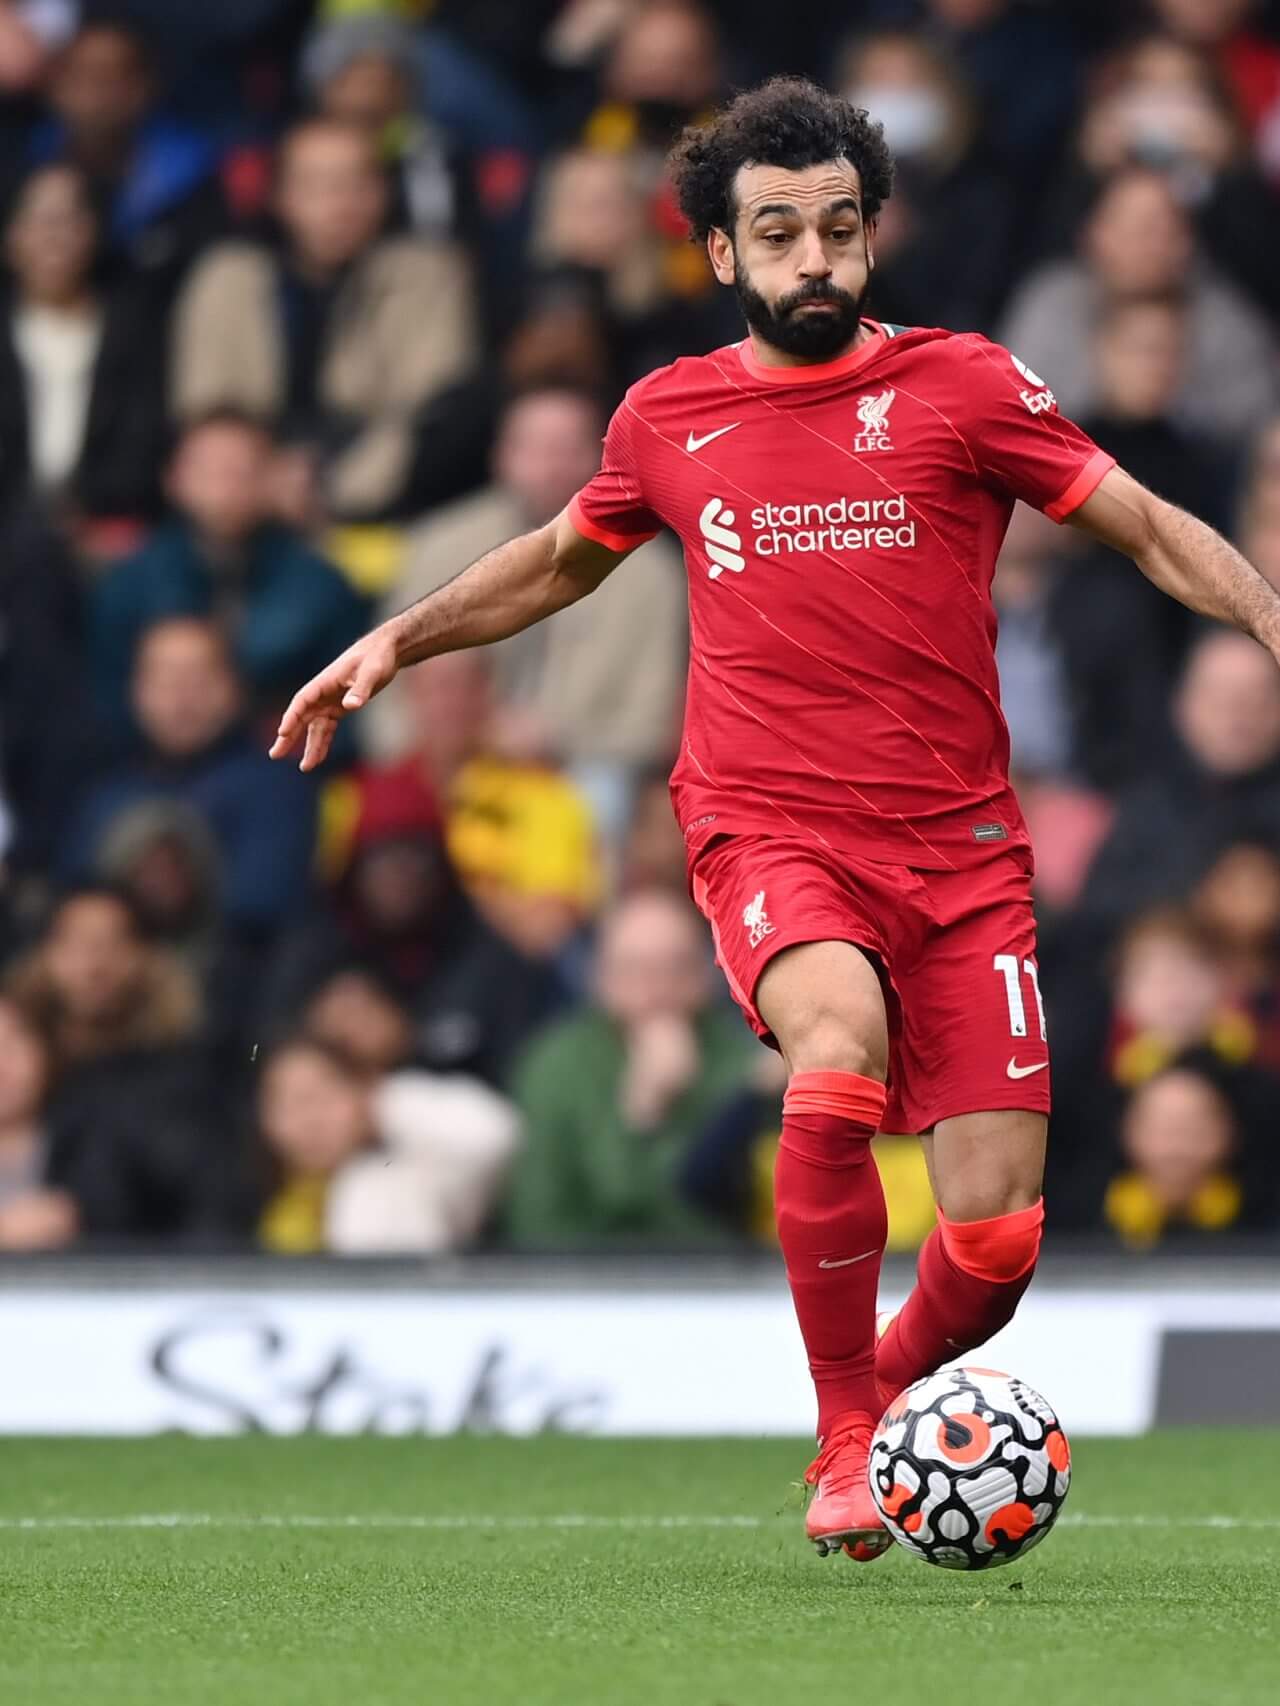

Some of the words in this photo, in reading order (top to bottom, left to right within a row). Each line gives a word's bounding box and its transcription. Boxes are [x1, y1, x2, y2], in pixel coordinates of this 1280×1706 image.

[1019, 389, 1057, 414] Epe
[751, 494, 905, 530] standard
[755, 520, 916, 556] chartered
[993, 954, 1047, 1042] 11
